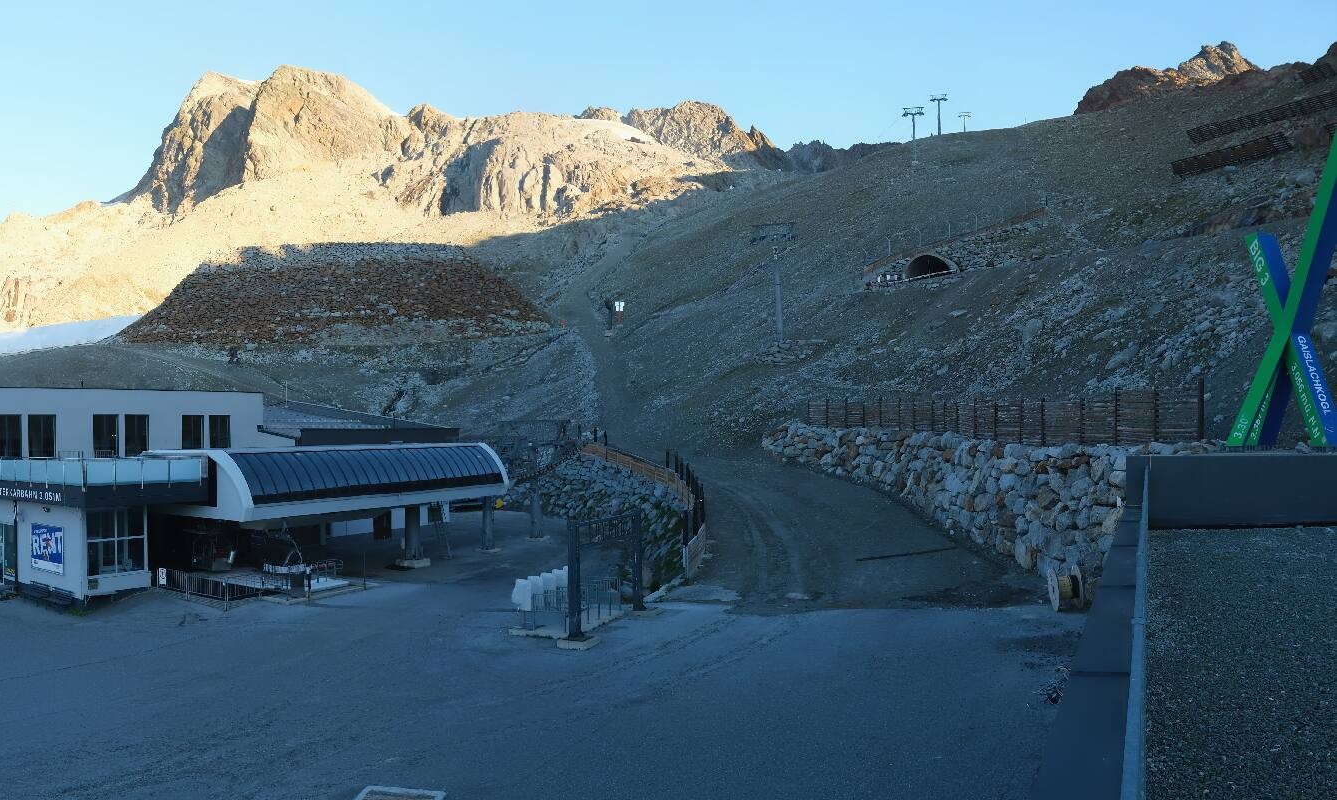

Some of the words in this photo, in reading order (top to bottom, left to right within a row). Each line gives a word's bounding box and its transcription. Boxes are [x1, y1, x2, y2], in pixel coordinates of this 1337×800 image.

[1250, 239, 1264, 272] BIG
[1261, 272, 1269, 286] 3
[1297, 335, 1332, 416] GAISLACHKOGL
[32, 531, 62, 555] RENT
